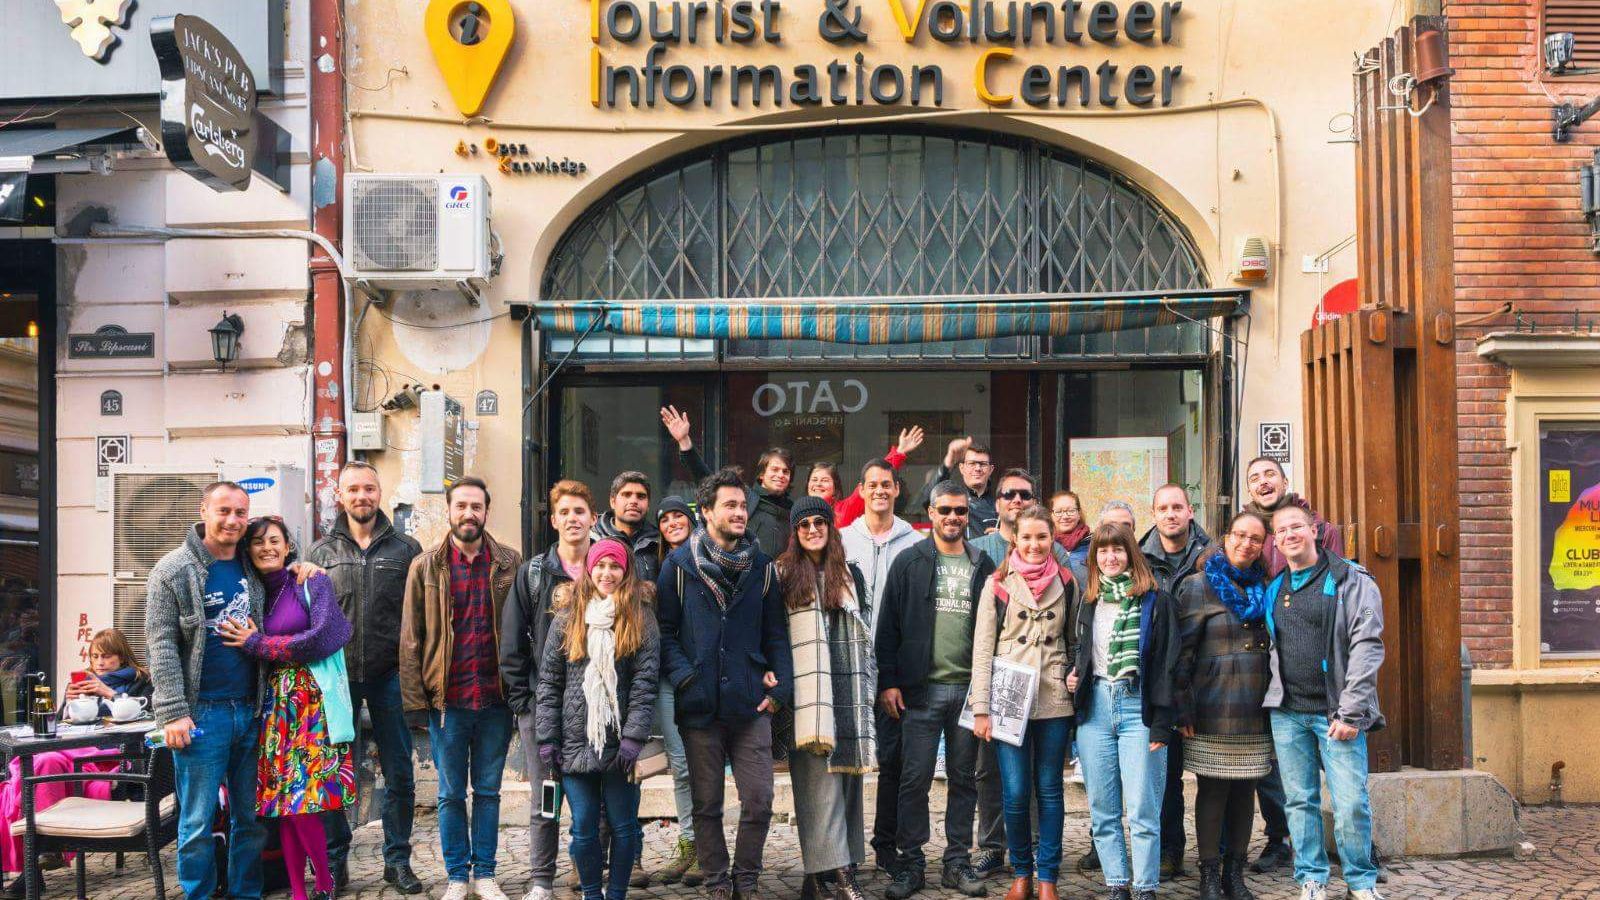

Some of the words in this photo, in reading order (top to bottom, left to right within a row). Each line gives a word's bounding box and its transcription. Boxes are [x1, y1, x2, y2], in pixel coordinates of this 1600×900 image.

[588, 0, 781, 43] Tourist
[819, 0, 867, 42] &
[888, 0, 1182, 43] Volunteer
[184, 26, 222, 68] JACK'S
[224, 56, 249, 92] PUB
[591, 41, 942, 107] Information
[975, 47, 1183, 107] Center
[191, 102, 245, 168] Carlsberg
[498, 155, 587, 177] Knowledge
[99, 340, 147, 356] Lipscani
[103, 399, 120, 412] 45
[480, 398, 495, 411] 47
[1566, 549, 1600, 560] CLUB
[79, 613, 88, 627] B
